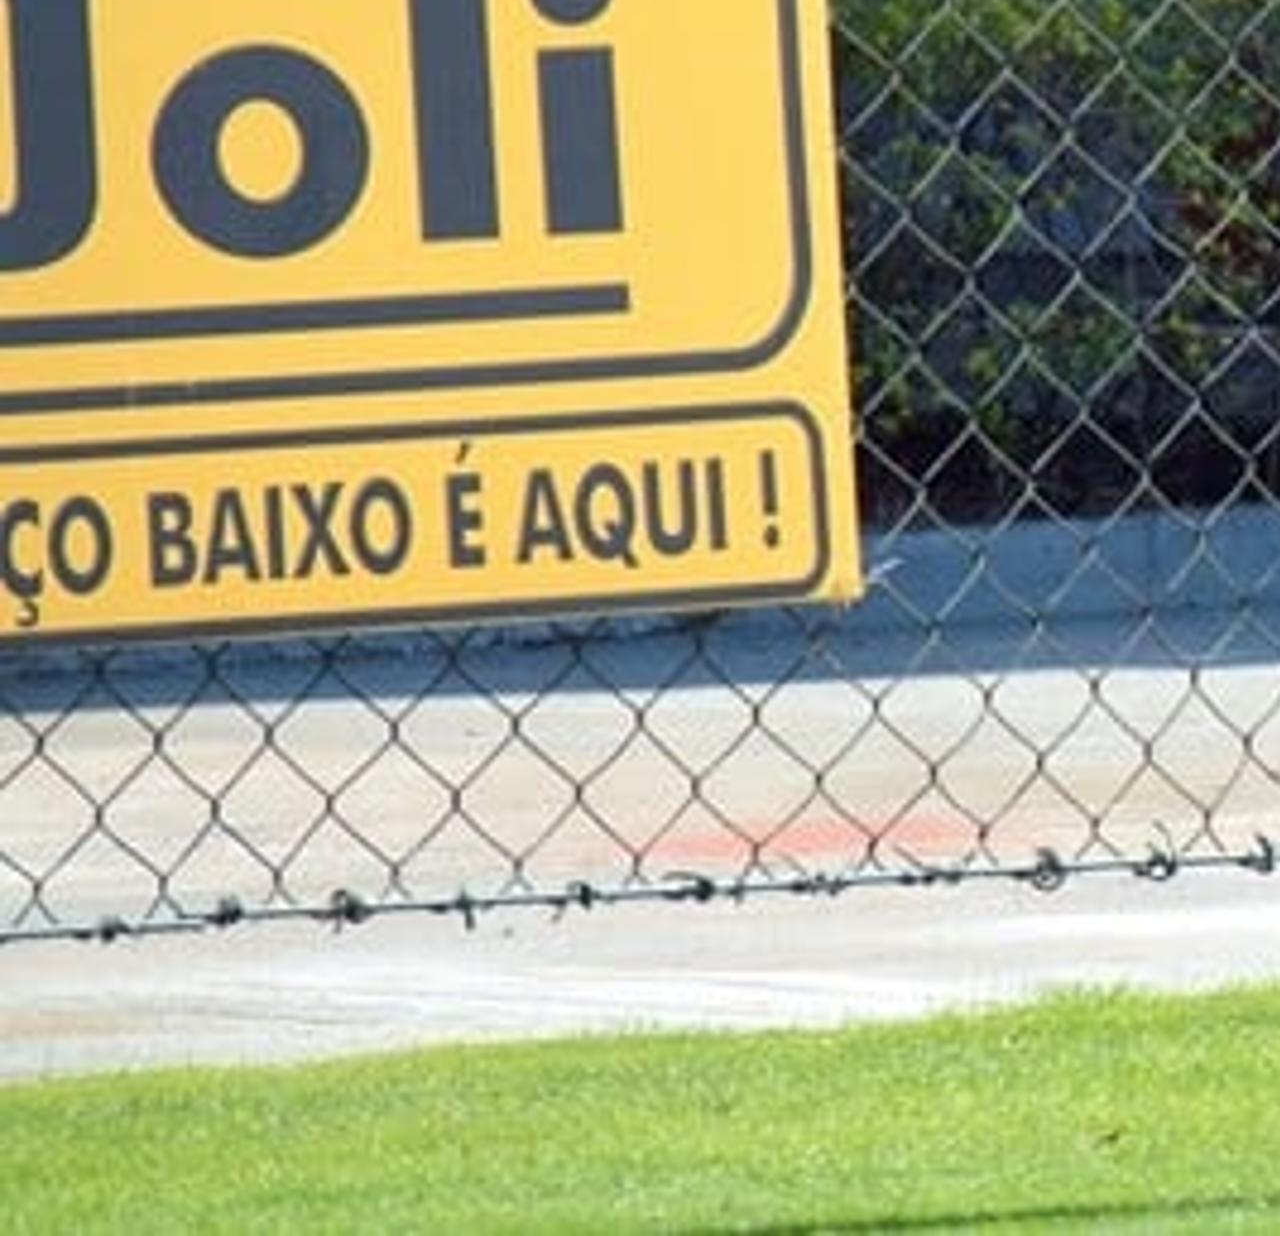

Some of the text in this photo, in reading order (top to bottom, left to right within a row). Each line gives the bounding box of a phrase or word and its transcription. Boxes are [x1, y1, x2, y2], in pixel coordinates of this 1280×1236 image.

[0, 494, 113, 627] ÇO
[146, 476, 412, 588] BAIXO
[446, 443, 486, 569] É
[517, 457, 729, 568] AQUI
